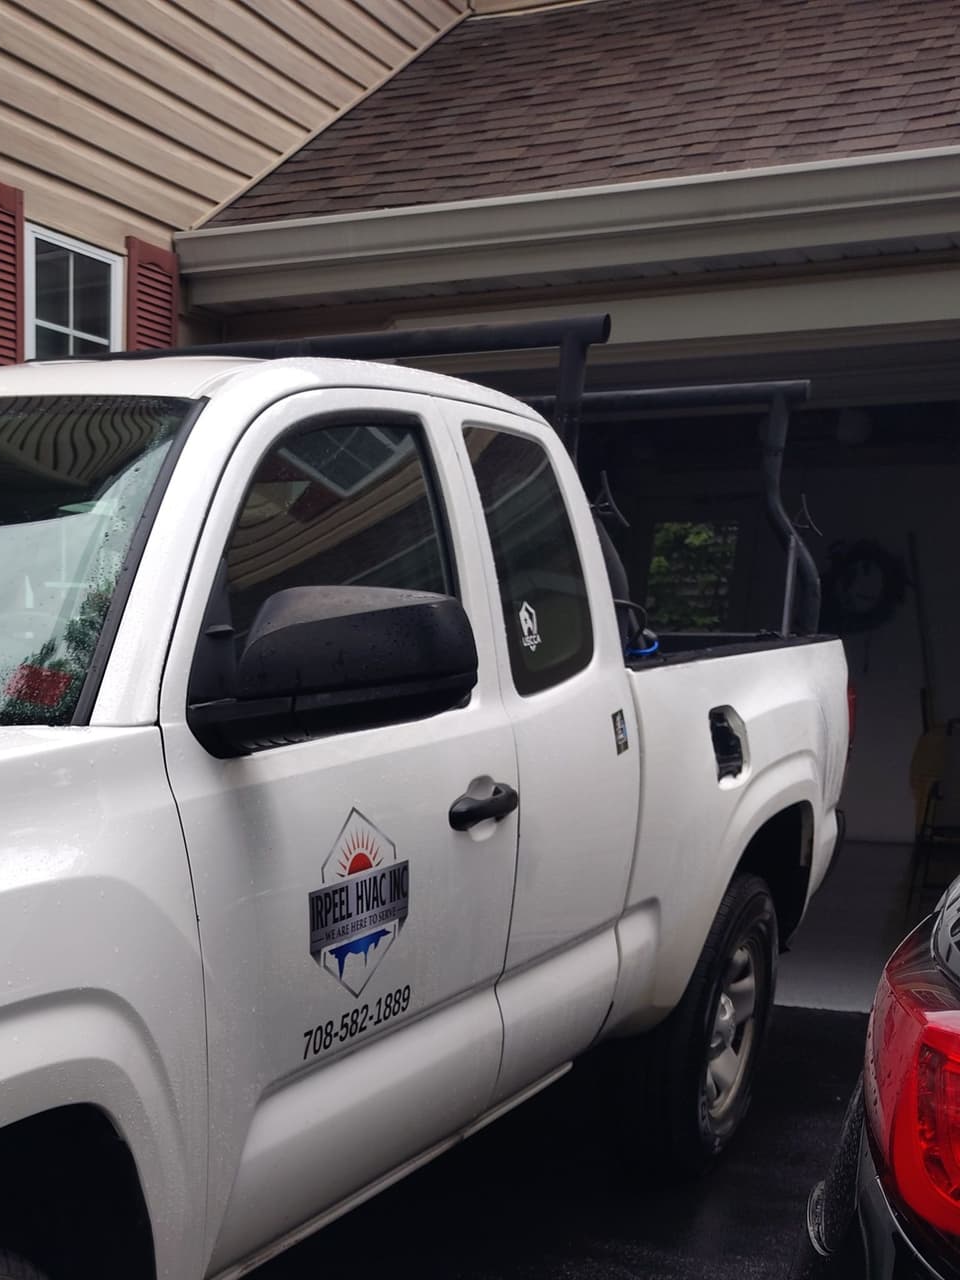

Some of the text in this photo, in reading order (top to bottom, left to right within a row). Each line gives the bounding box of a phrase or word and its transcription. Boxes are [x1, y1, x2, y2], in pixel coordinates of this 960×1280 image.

[312, 865, 408, 931] IRPEEL HVAC INC
[325, 906, 396, 941] WE ARE HERE TO SERVE
[303, 984, 411, 1060] 708-582-1889
